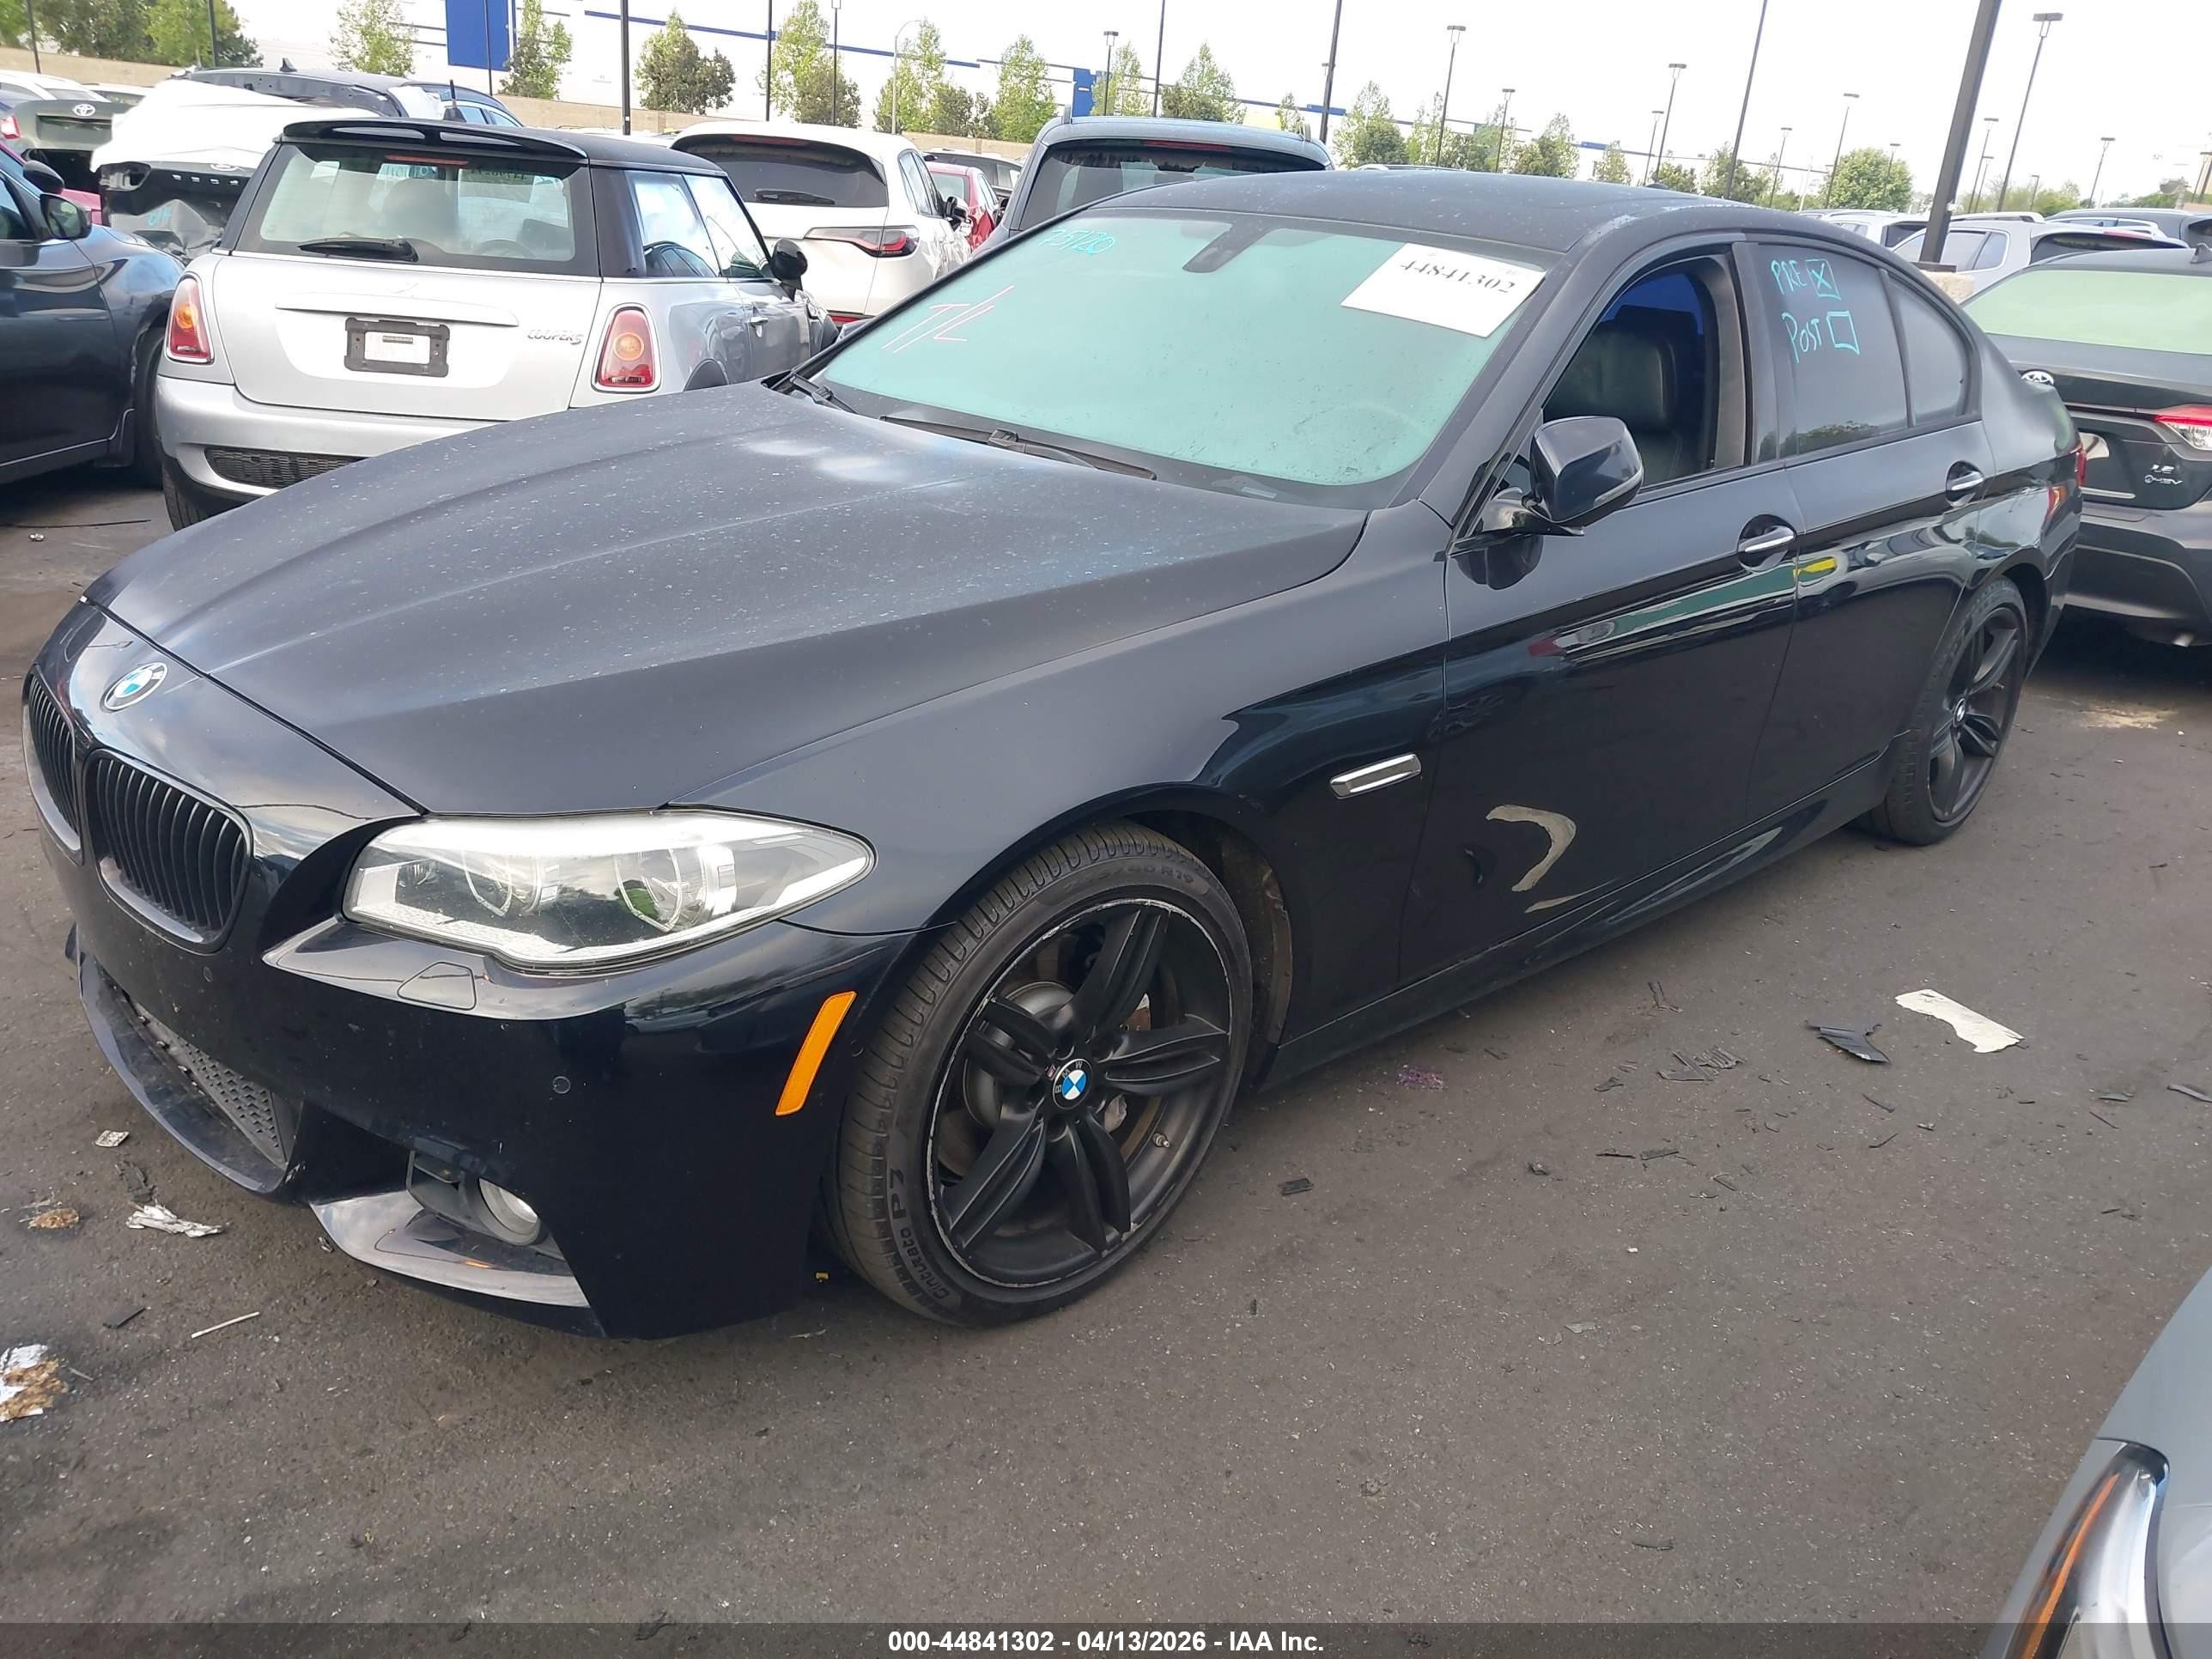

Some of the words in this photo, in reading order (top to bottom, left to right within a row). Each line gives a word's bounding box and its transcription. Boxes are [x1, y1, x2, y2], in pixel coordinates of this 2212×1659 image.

[1401, 260, 1516, 293] 44841302
[1771, 260, 1807, 295] PRE
[1054, 1061, 1083, 1093] BMW
